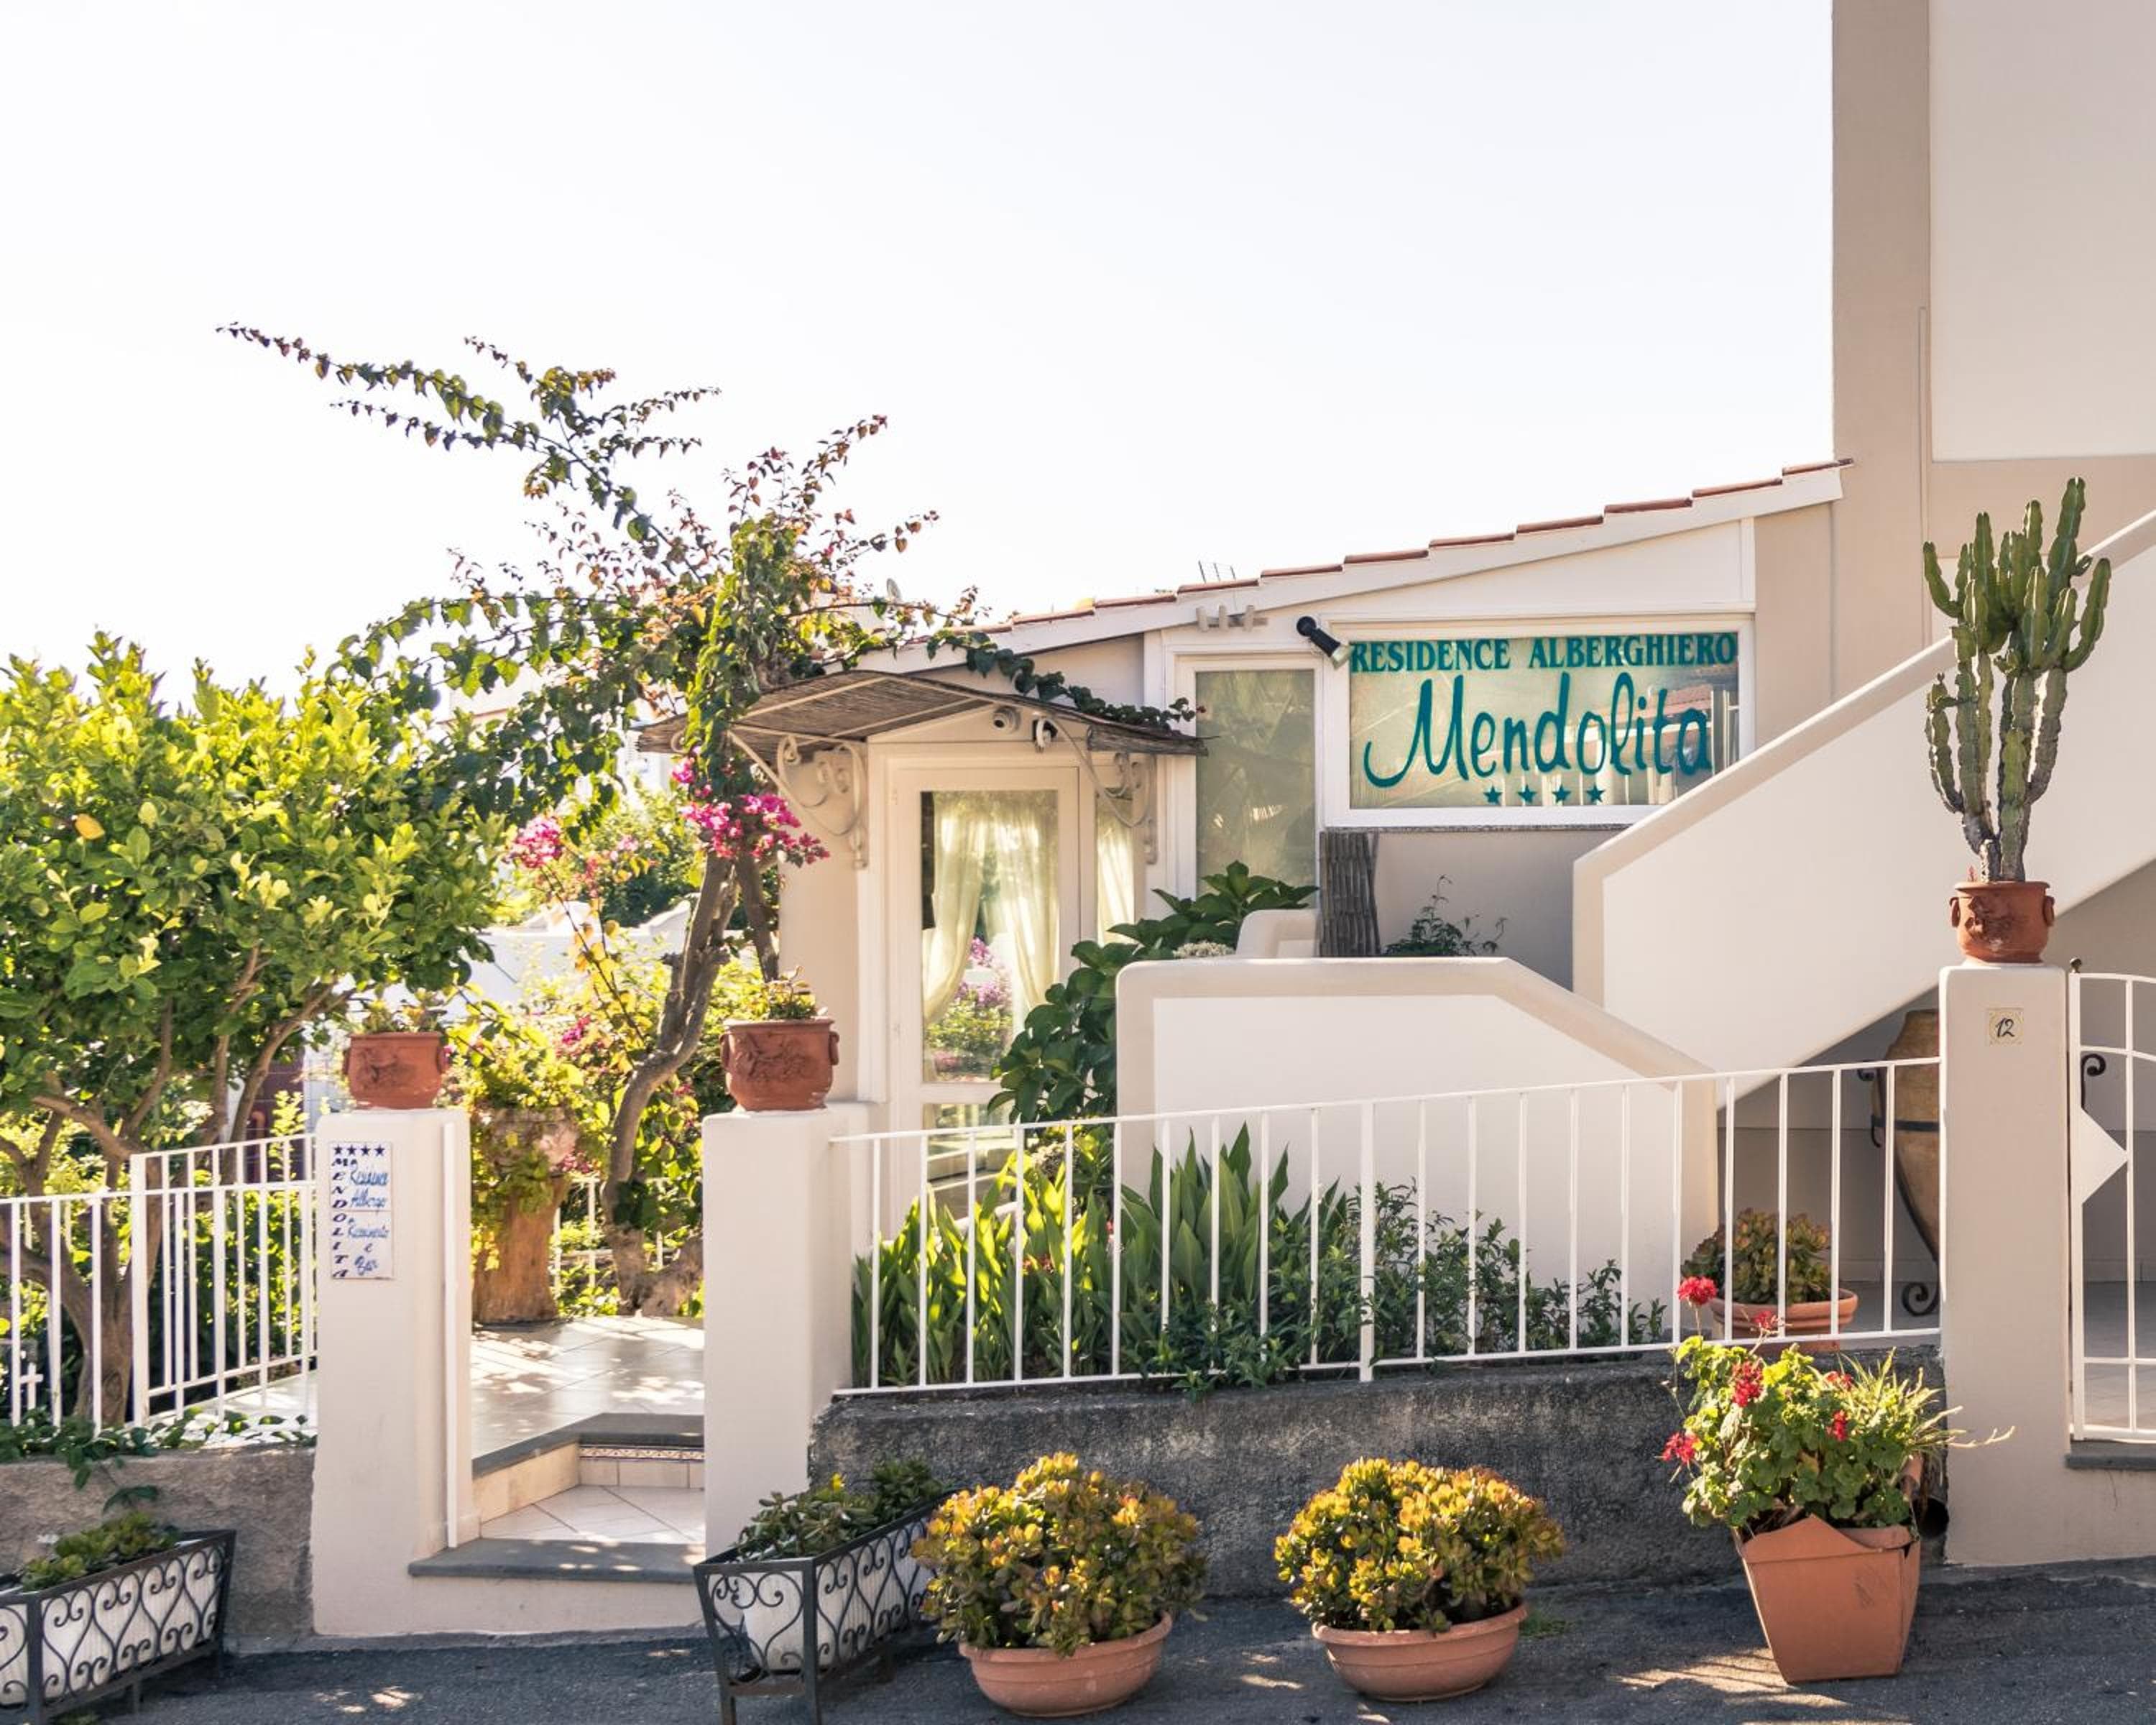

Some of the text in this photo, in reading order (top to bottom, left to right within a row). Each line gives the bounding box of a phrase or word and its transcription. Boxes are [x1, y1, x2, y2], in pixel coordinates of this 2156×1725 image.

[1351, 632, 1736, 673] RESIDENCE ALBERGHIERO
[1365, 671, 1713, 788] Mendolita
[1995, 1017, 2015, 1037] 12
